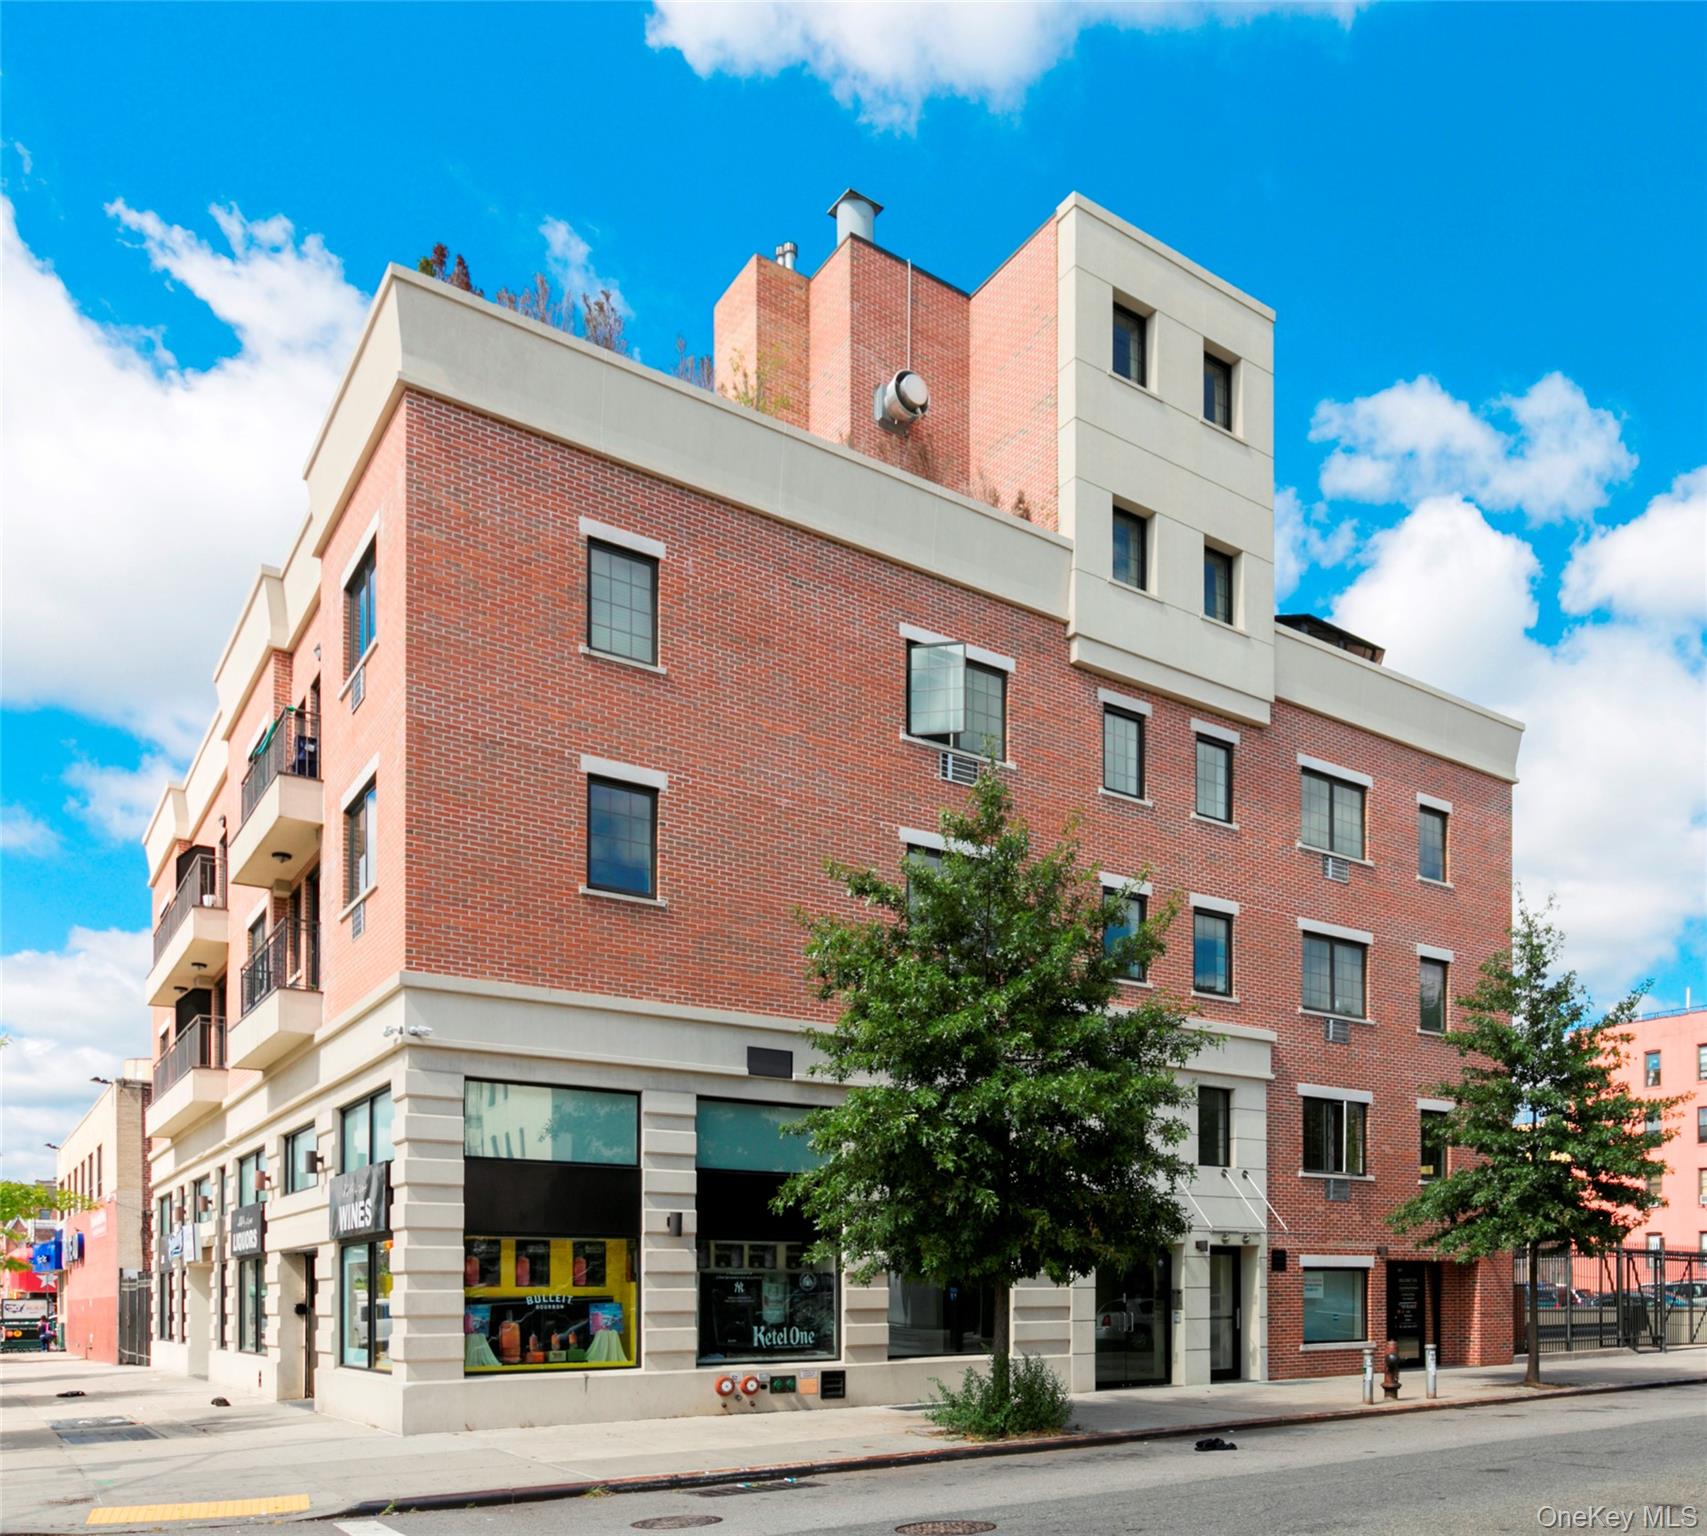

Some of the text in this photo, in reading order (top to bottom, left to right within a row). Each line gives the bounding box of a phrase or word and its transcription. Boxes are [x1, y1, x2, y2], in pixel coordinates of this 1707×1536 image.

[339, 1198, 372, 1231] WINES
[233, 1229, 258, 1252] LIQUORS
[526, 1294, 573, 1305] BULLEIT
[752, 1325, 815, 1348] Ketel One
